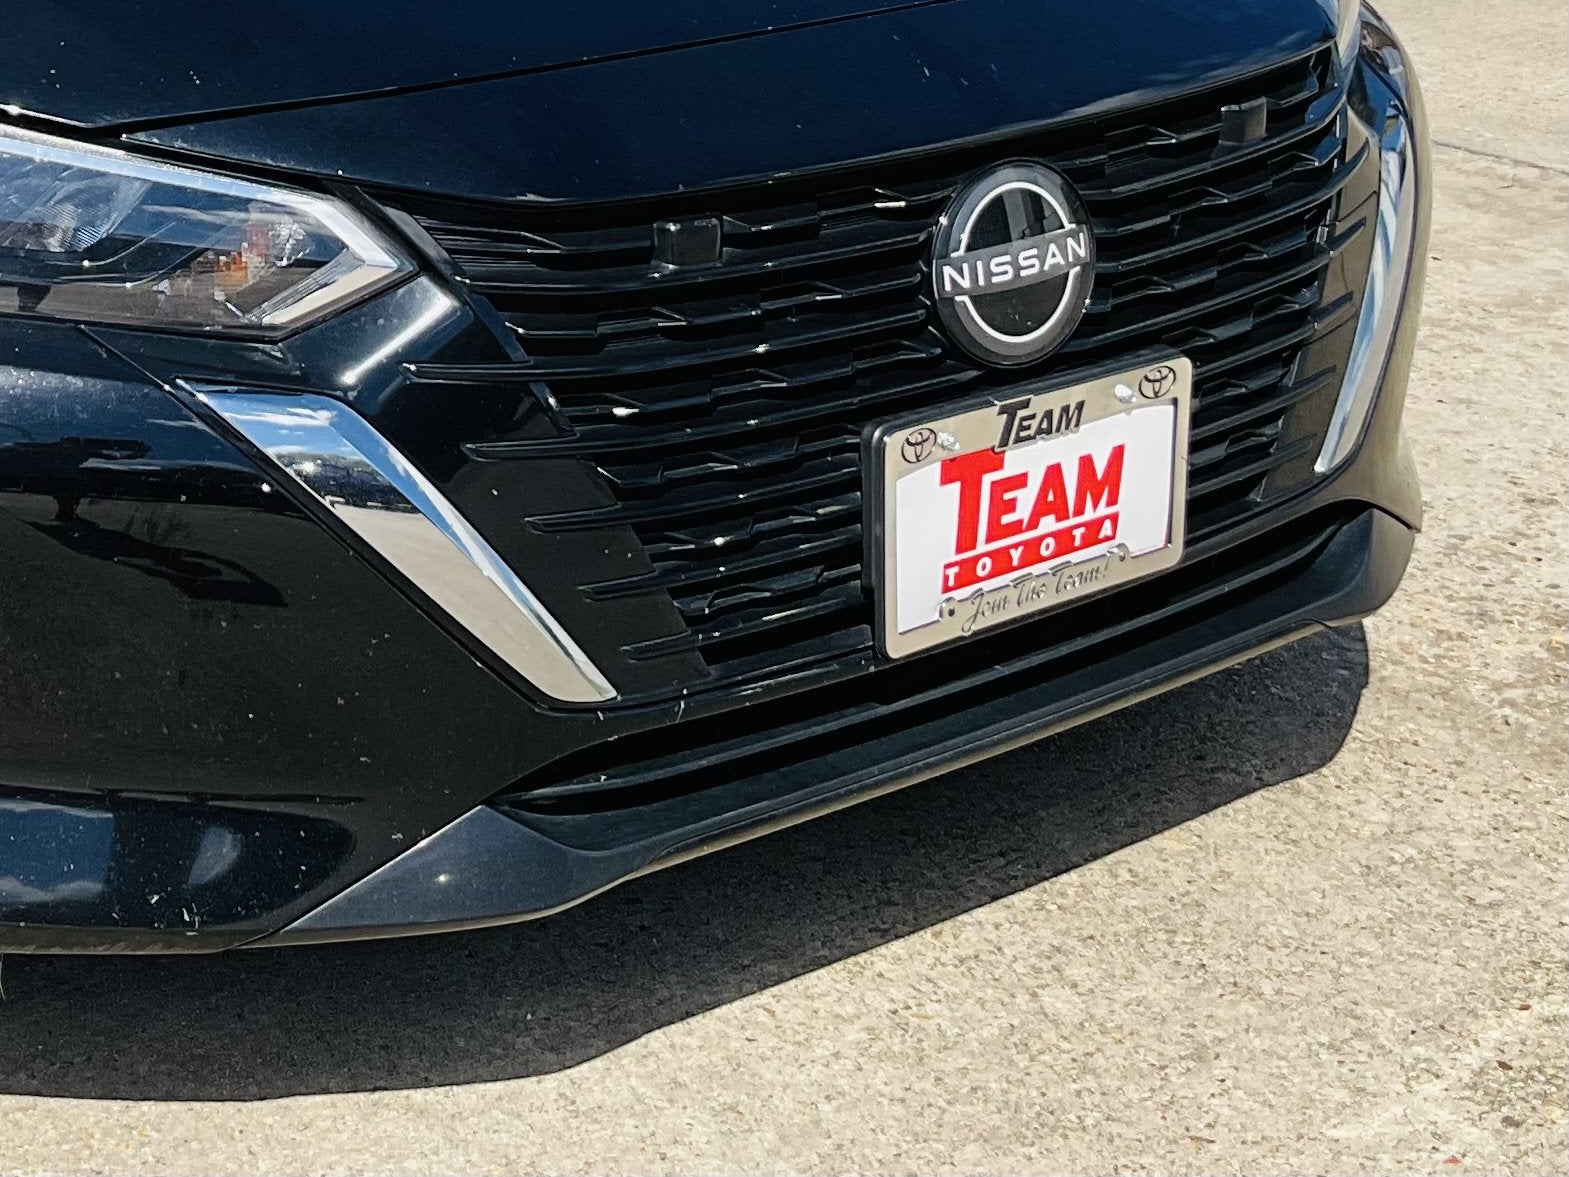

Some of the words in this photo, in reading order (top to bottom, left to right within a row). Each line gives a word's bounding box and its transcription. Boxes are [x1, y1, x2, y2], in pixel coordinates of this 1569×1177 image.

[941, 232, 1087, 292] NISSAN
[995, 397, 1085, 450] TEAM
[939, 443, 1126, 556] TEAM
[944, 521, 1114, 587] TOYOTA
